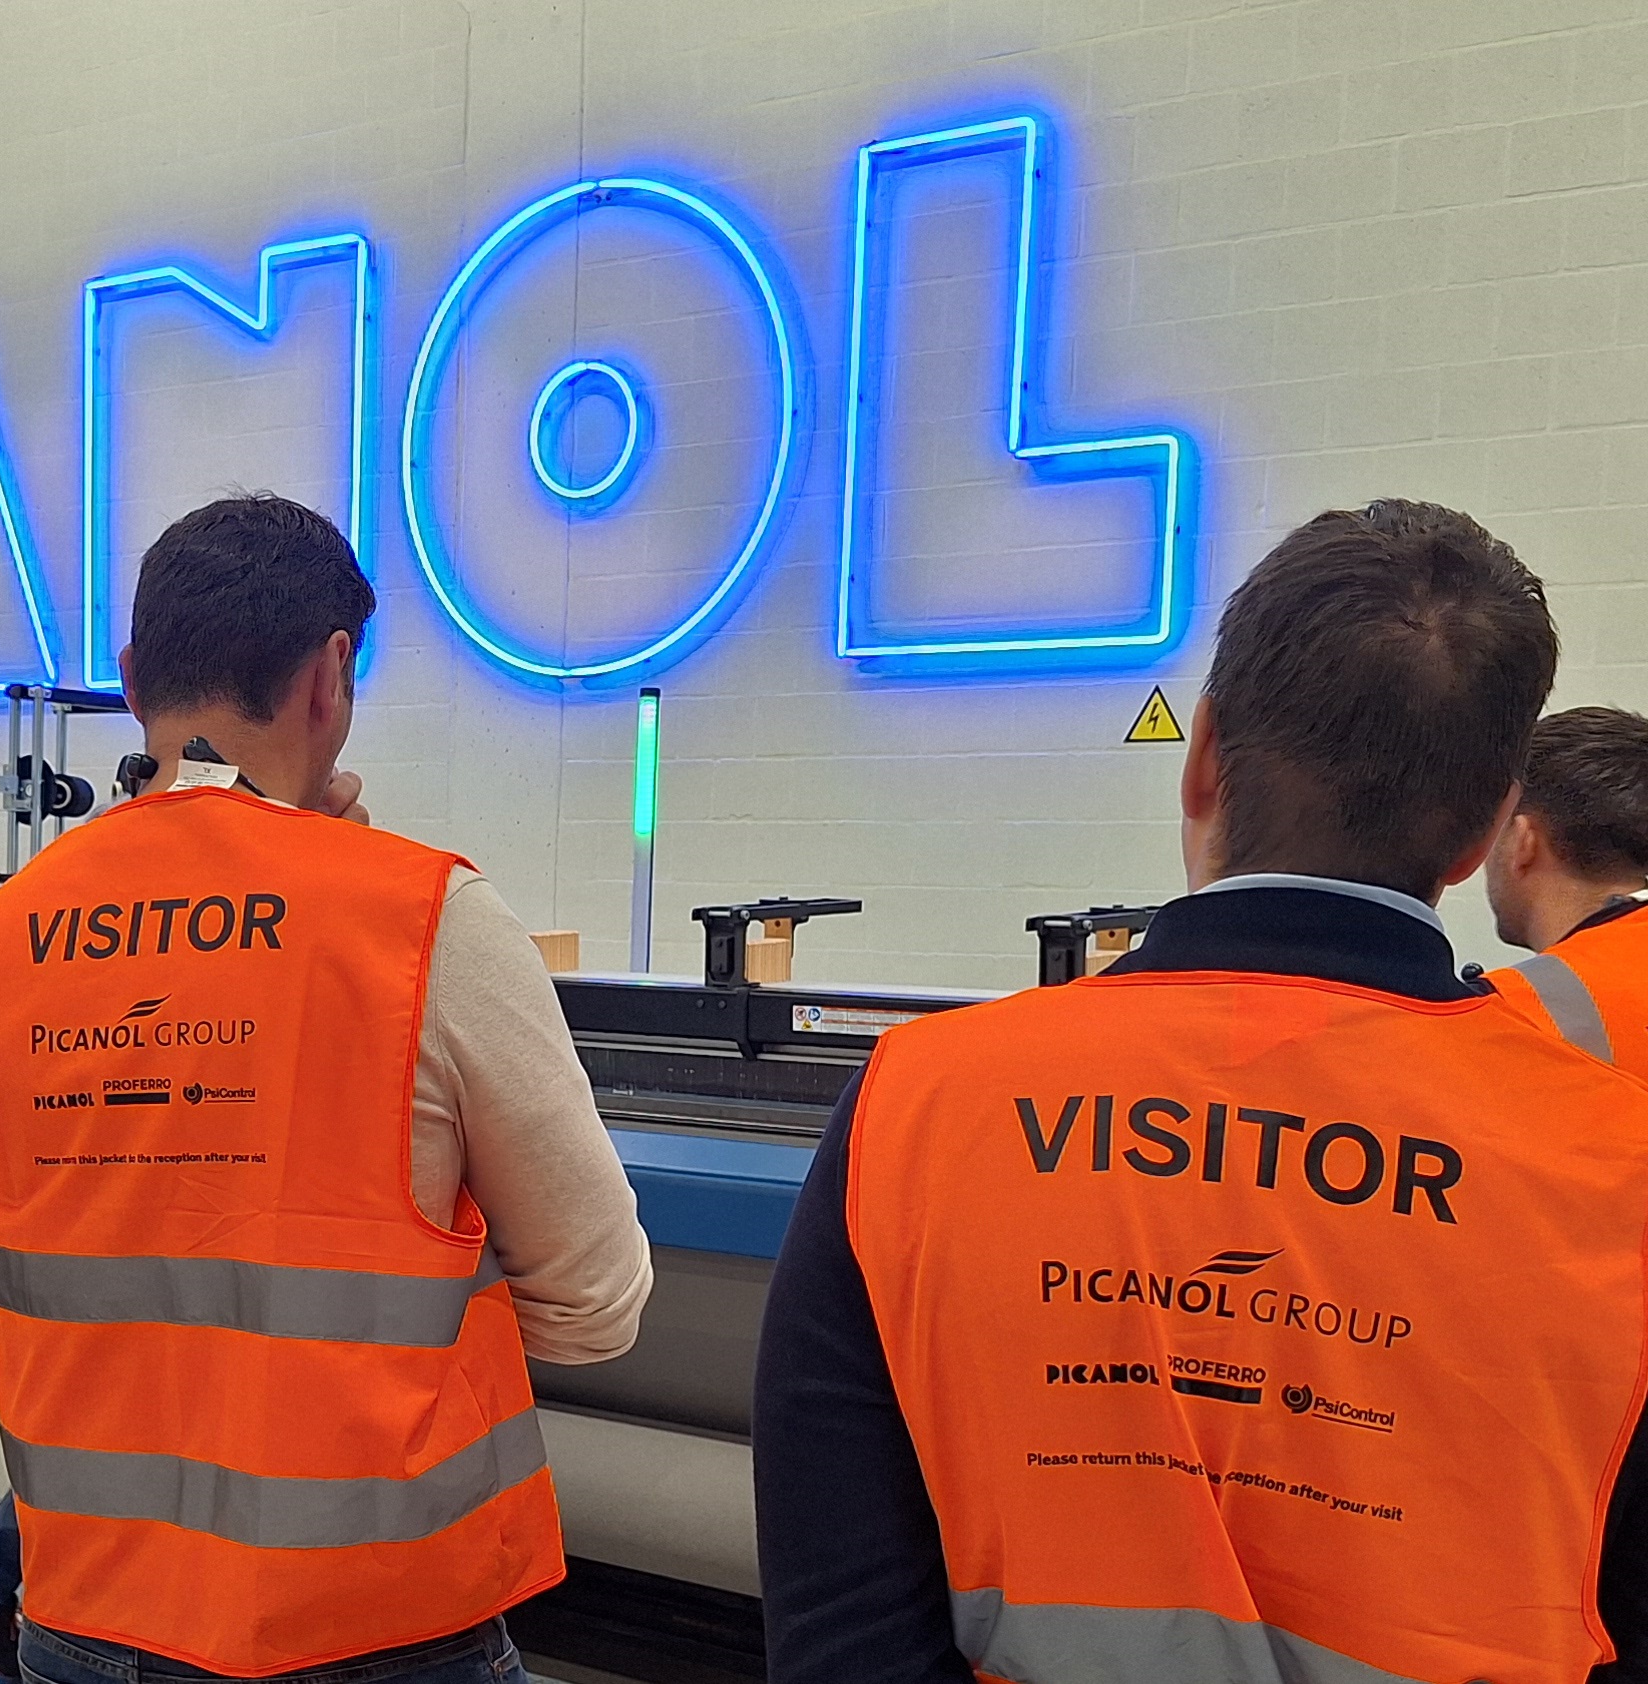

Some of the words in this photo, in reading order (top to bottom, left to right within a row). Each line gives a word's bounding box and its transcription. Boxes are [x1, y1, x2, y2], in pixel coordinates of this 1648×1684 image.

[28, 893, 287, 965] VISITOR
[31, 1024, 145, 1055] PICANOL
[155, 1019, 256, 1047] GROUP
[33, 1092, 95, 1111] PICANOL
[102, 1078, 172, 1092] PROFERRO
[204, 1087, 256, 1098] PsiControl
[78, 1154, 98, 1165] this
[137, 1153, 152, 1164] the
[154, 1152, 202, 1165] reception
[204, 1151, 229, 1163] after
[231, 1153, 250, 1164] your
[1013, 1095, 1463, 1225] VISITOR
[1041, 1260, 1236, 1319] PICANOL
[1251, 1288, 1412, 1349] GROUP
[1046, 1362, 1160, 1386] PICANOL
[1313, 1397, 1396, 1427] PsiControl
[1027, 1452, 1078, 1467] Please
[1082, 1452, 1132, 1466] return
[1135, 1451, 1166, 1466] this
[1288, 1483, 1330, 1503] after
[1330, 1496, 1369, 1515] your
[1370, 1504, 1403, 1522] visit
